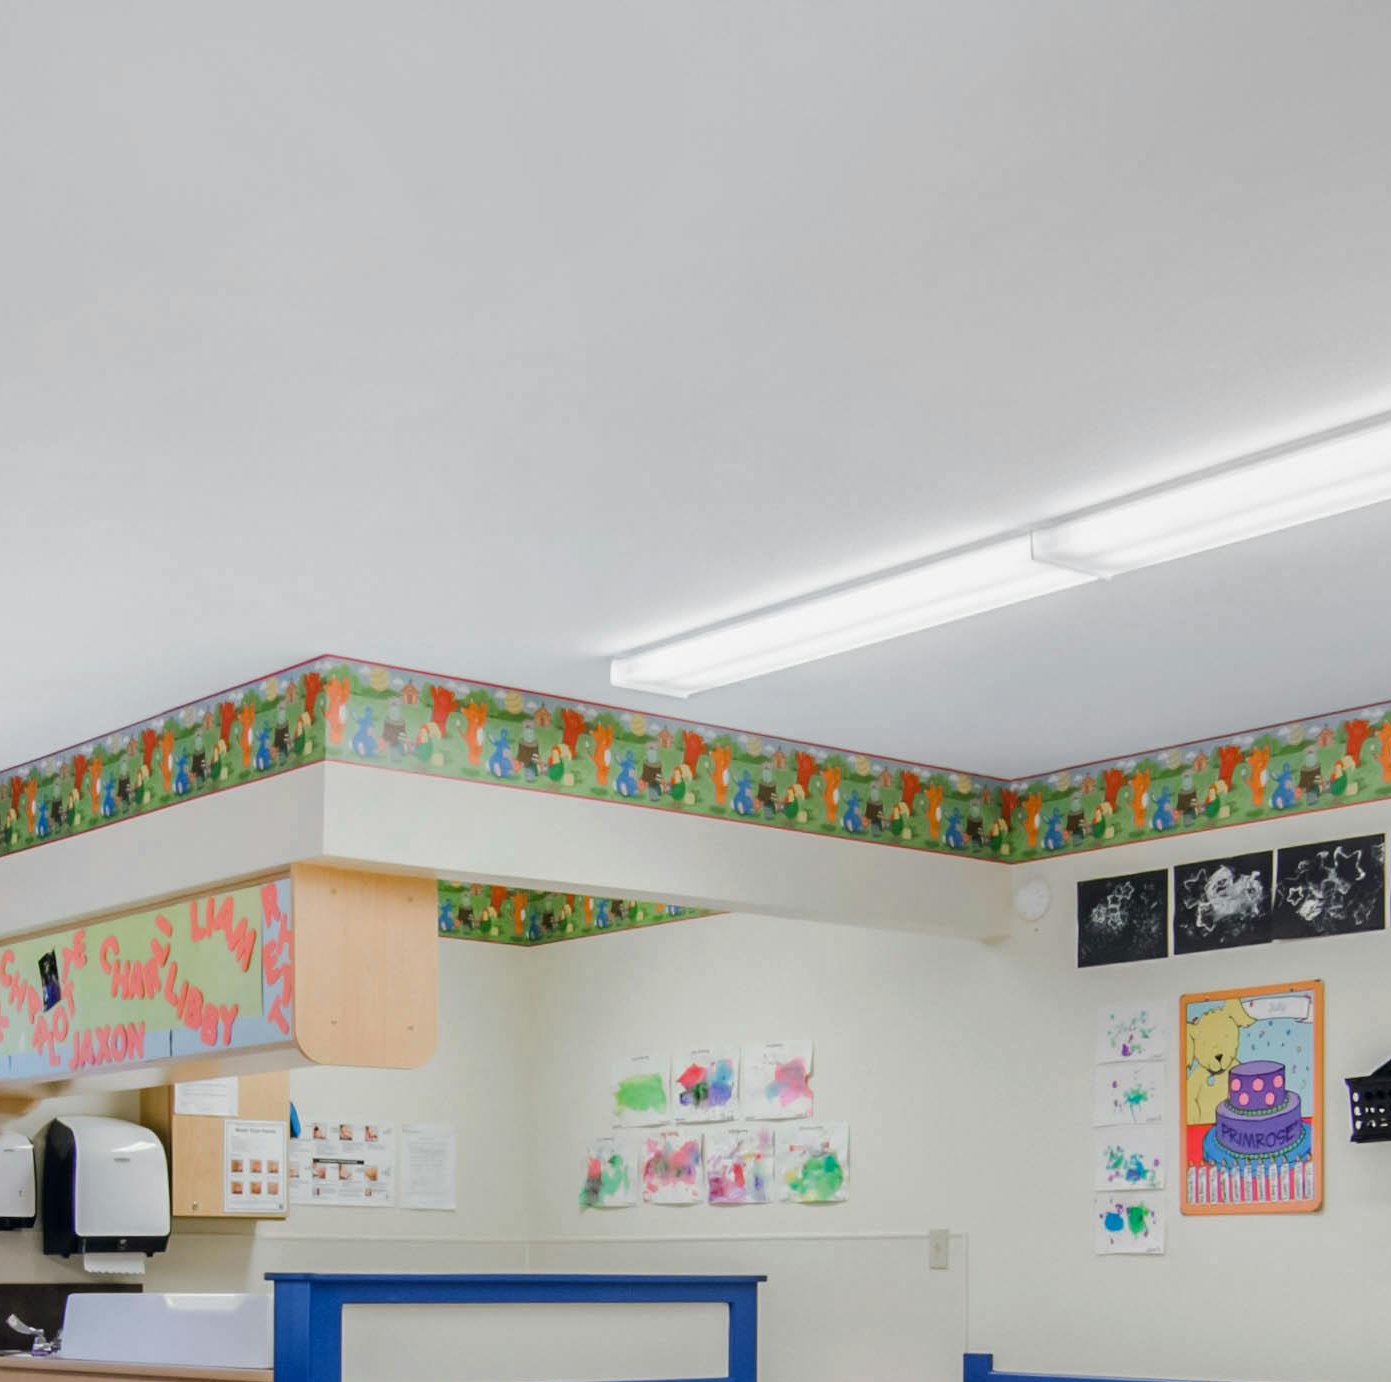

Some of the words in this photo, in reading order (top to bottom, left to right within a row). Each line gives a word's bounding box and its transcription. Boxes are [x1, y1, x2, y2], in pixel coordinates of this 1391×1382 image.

[165, 961, 239, 1046] LIBBY
[69, 1020, 146, 1071] JAXON
[1220, 1119, 1296, 1149] PRIMROSE
